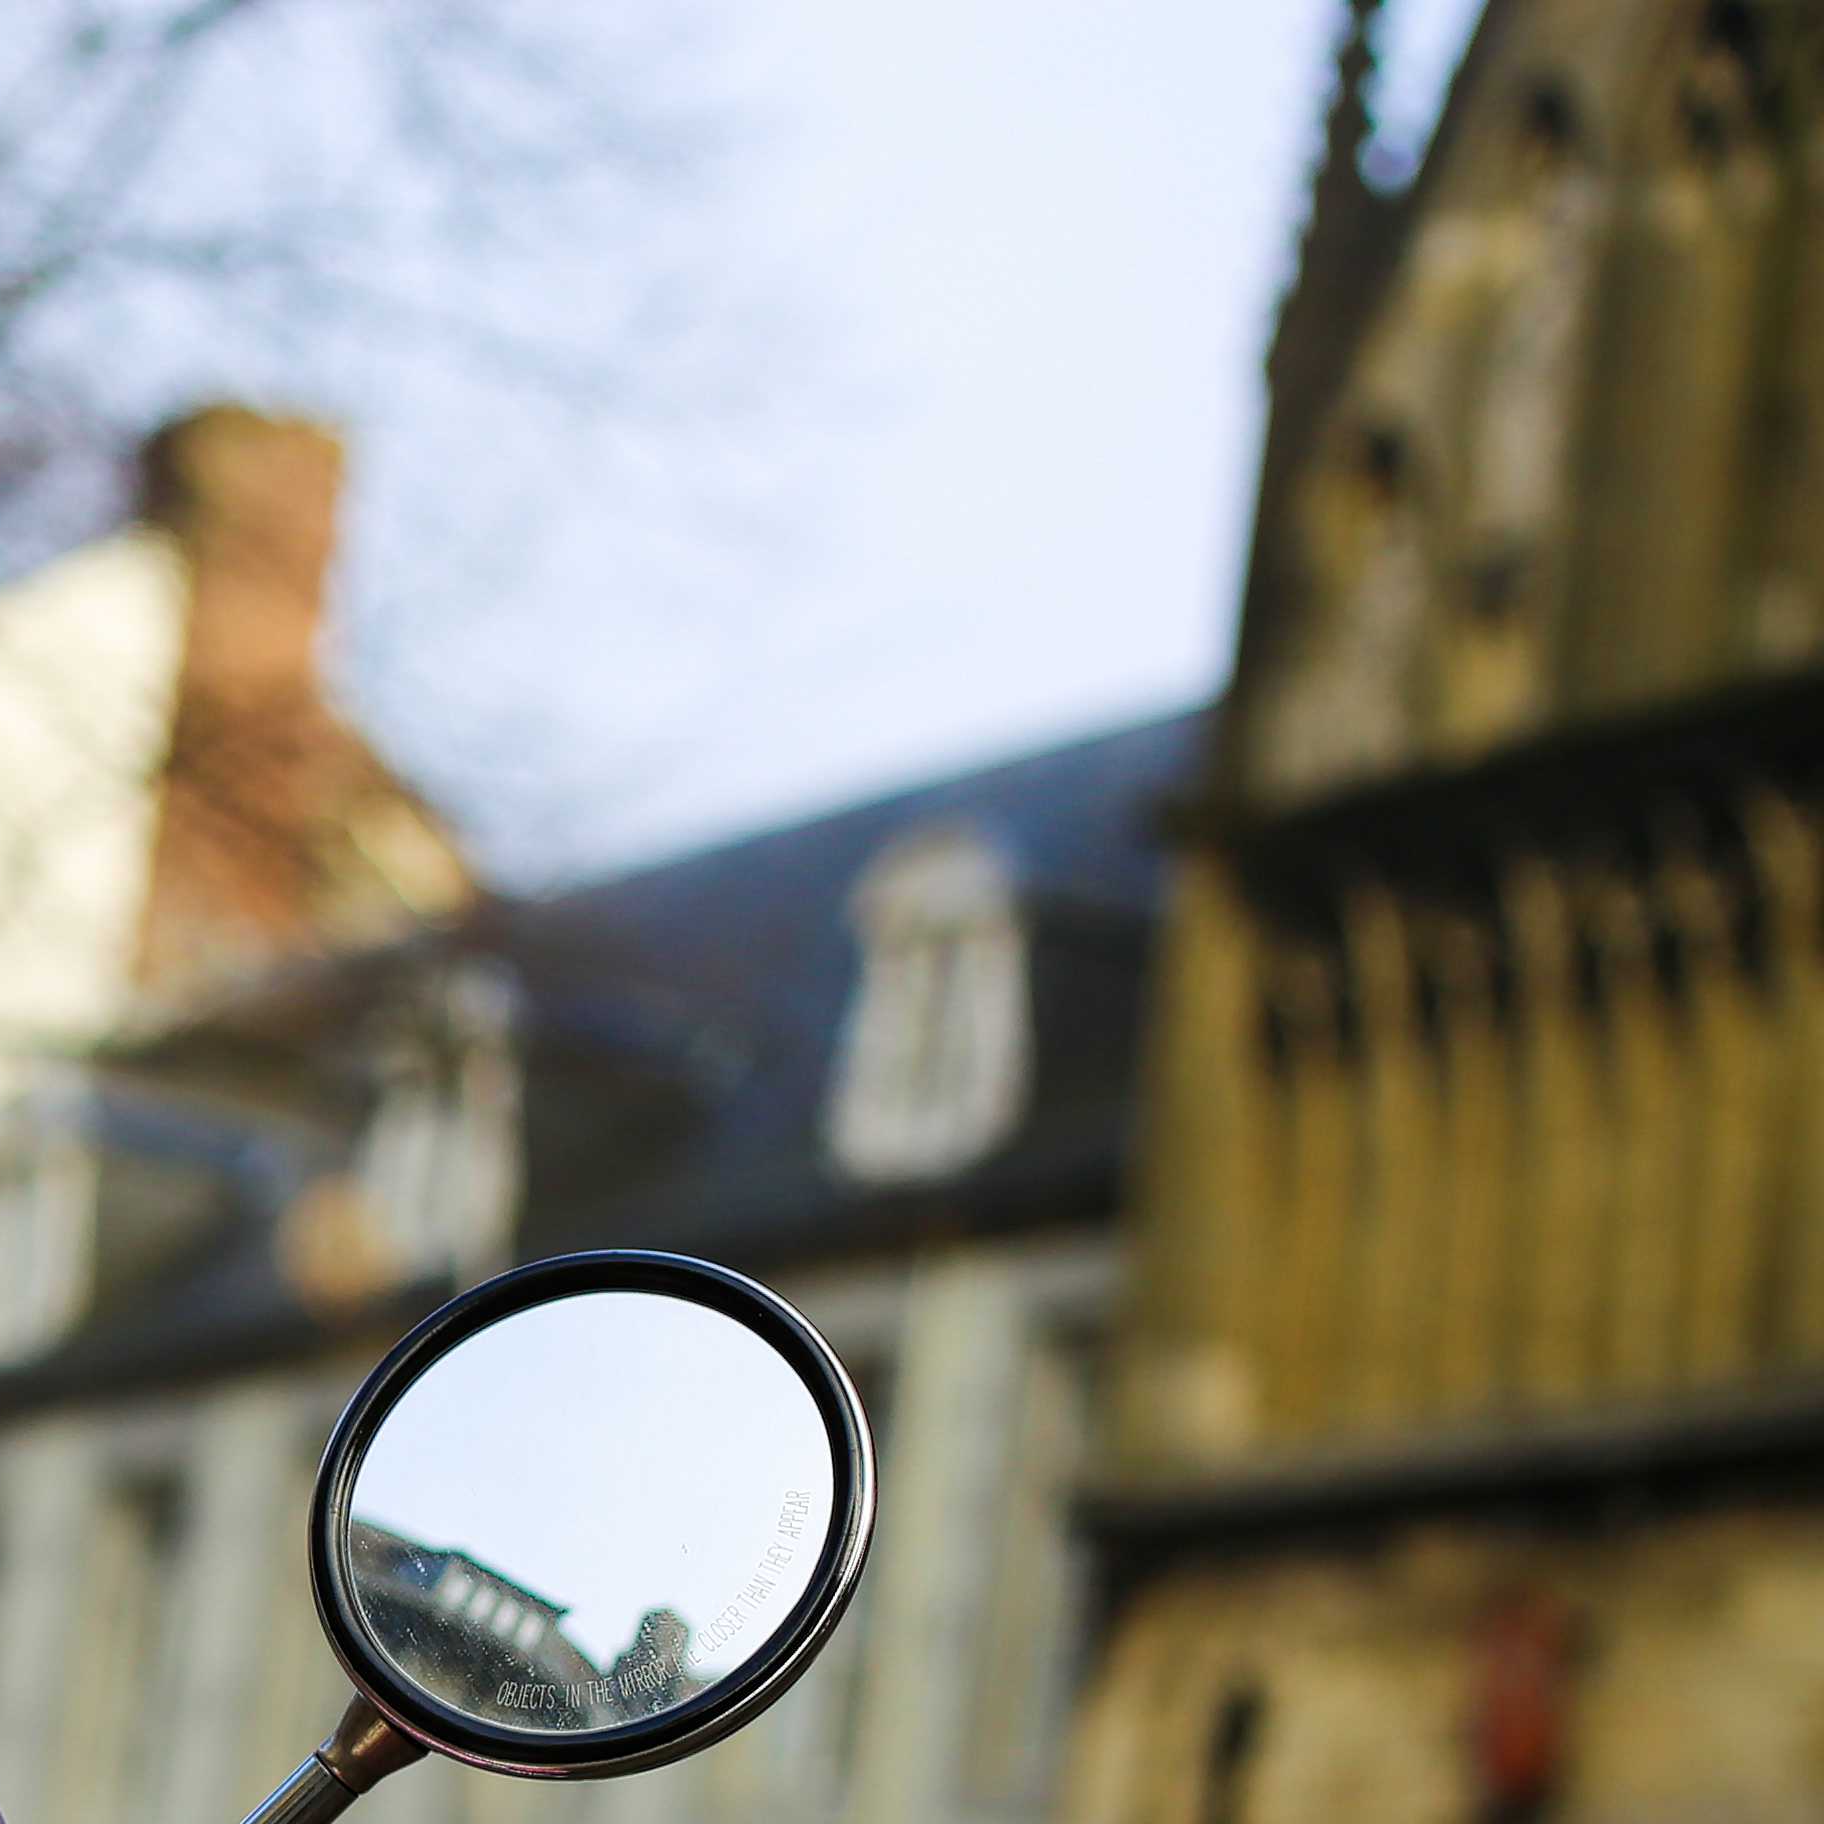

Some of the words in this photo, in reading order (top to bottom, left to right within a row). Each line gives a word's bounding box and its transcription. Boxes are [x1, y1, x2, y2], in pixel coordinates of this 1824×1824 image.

[496, 1679, 556, 1710] OBJECTS
[565, 1683, 581, 1709] IN
[588, 1677, 614, 1705] THE
[618, 1660, 674, 1698] MIRROR
[697, 1604, 748, 1653] CLOSER
[736, 1571, 777, 1609] THAN
[758, 1541, 794, 1576] THEY
[777, 1489, 812, 1541] APPEAR
